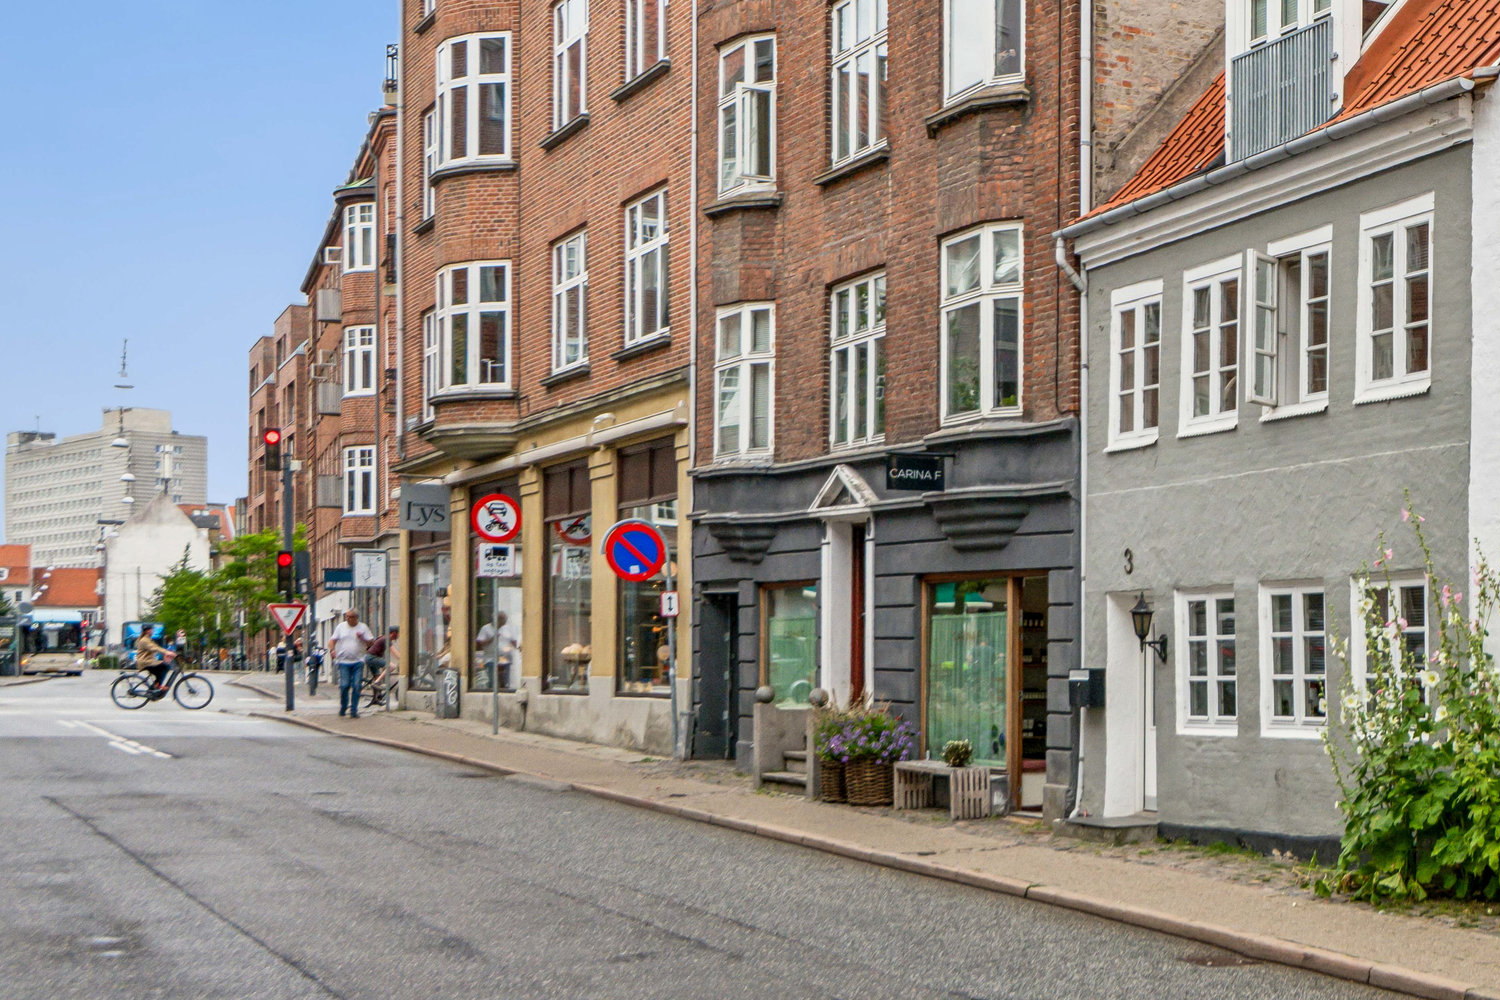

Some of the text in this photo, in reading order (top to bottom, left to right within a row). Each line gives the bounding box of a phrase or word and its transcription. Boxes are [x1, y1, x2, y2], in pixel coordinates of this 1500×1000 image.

[889, 467, 942, 480] CARINA F
[406, 501, 445, 526] Lys
[1124, 548, 1134, 575] 3
